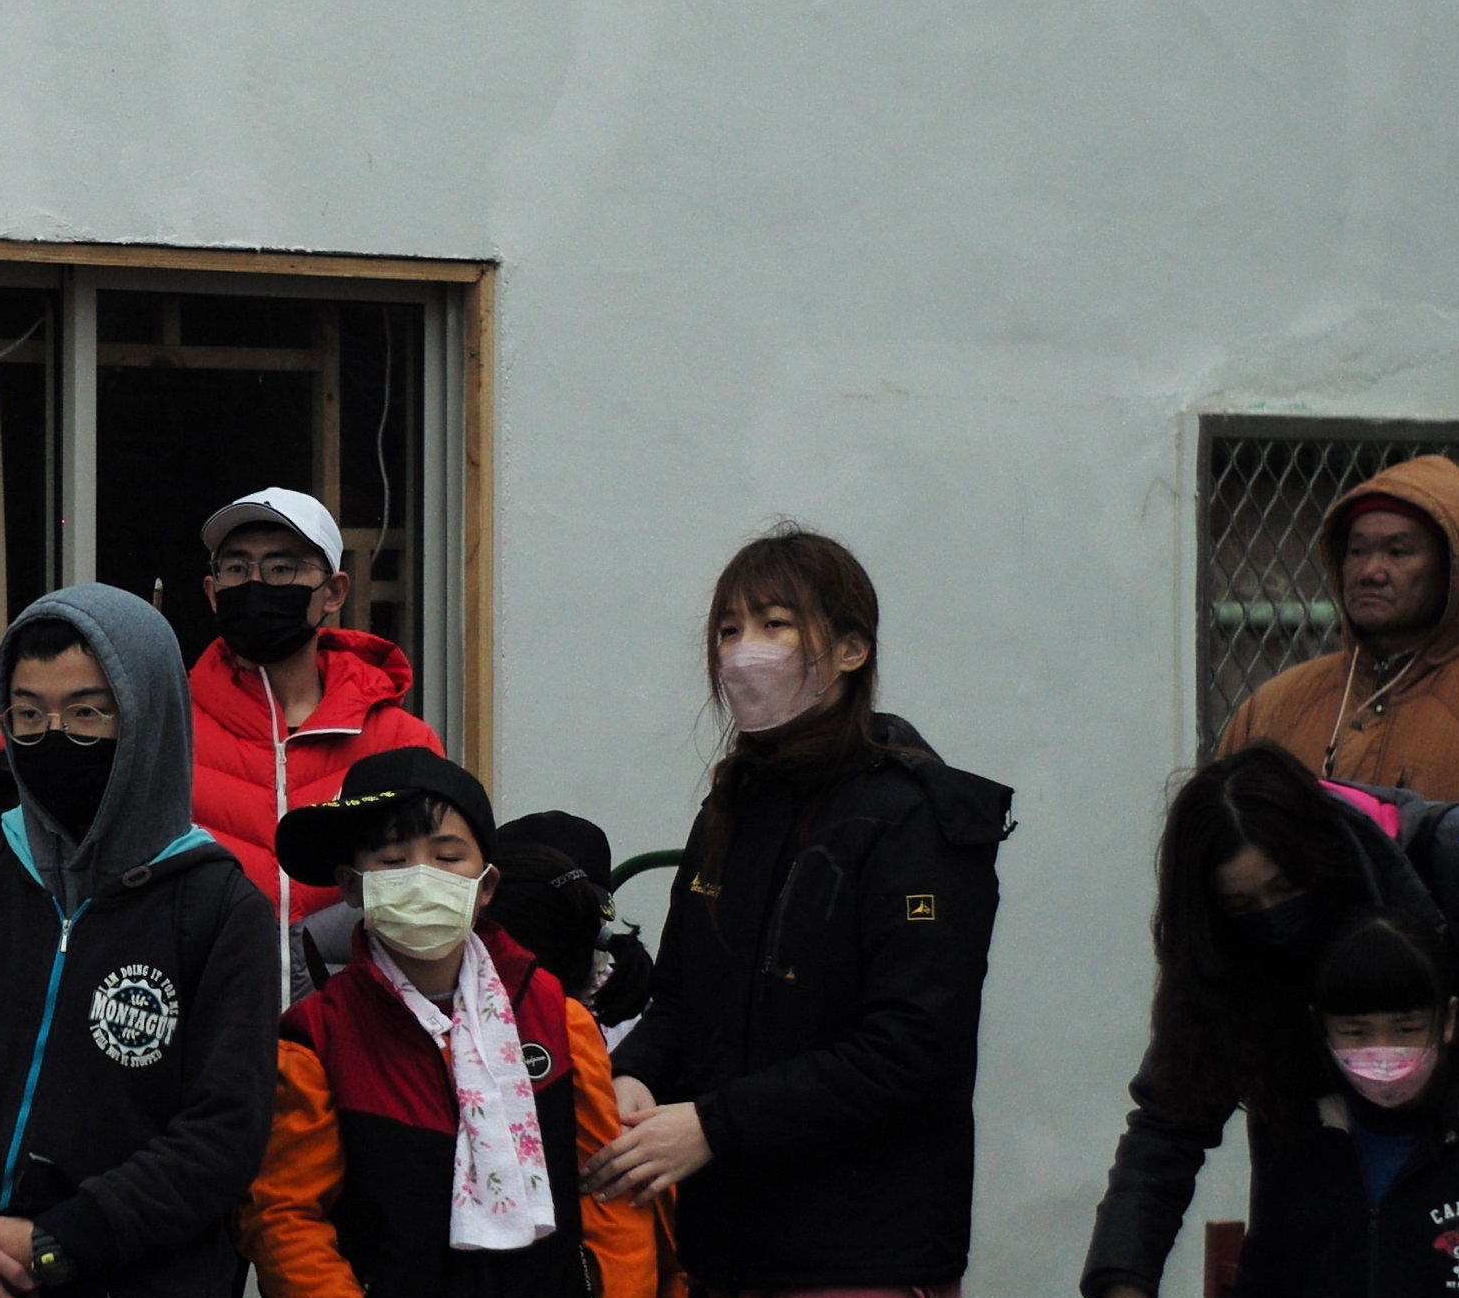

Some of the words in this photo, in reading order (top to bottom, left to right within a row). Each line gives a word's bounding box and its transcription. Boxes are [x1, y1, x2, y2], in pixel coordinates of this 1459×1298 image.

[103, 971, 120, 988] AM
[120, 963, 149, 978] DOING
[150, 967, 163, 982] IT
[161, 977, 177, 1000] FOR
[88, 989, 179, 1047] MONTAGUT
